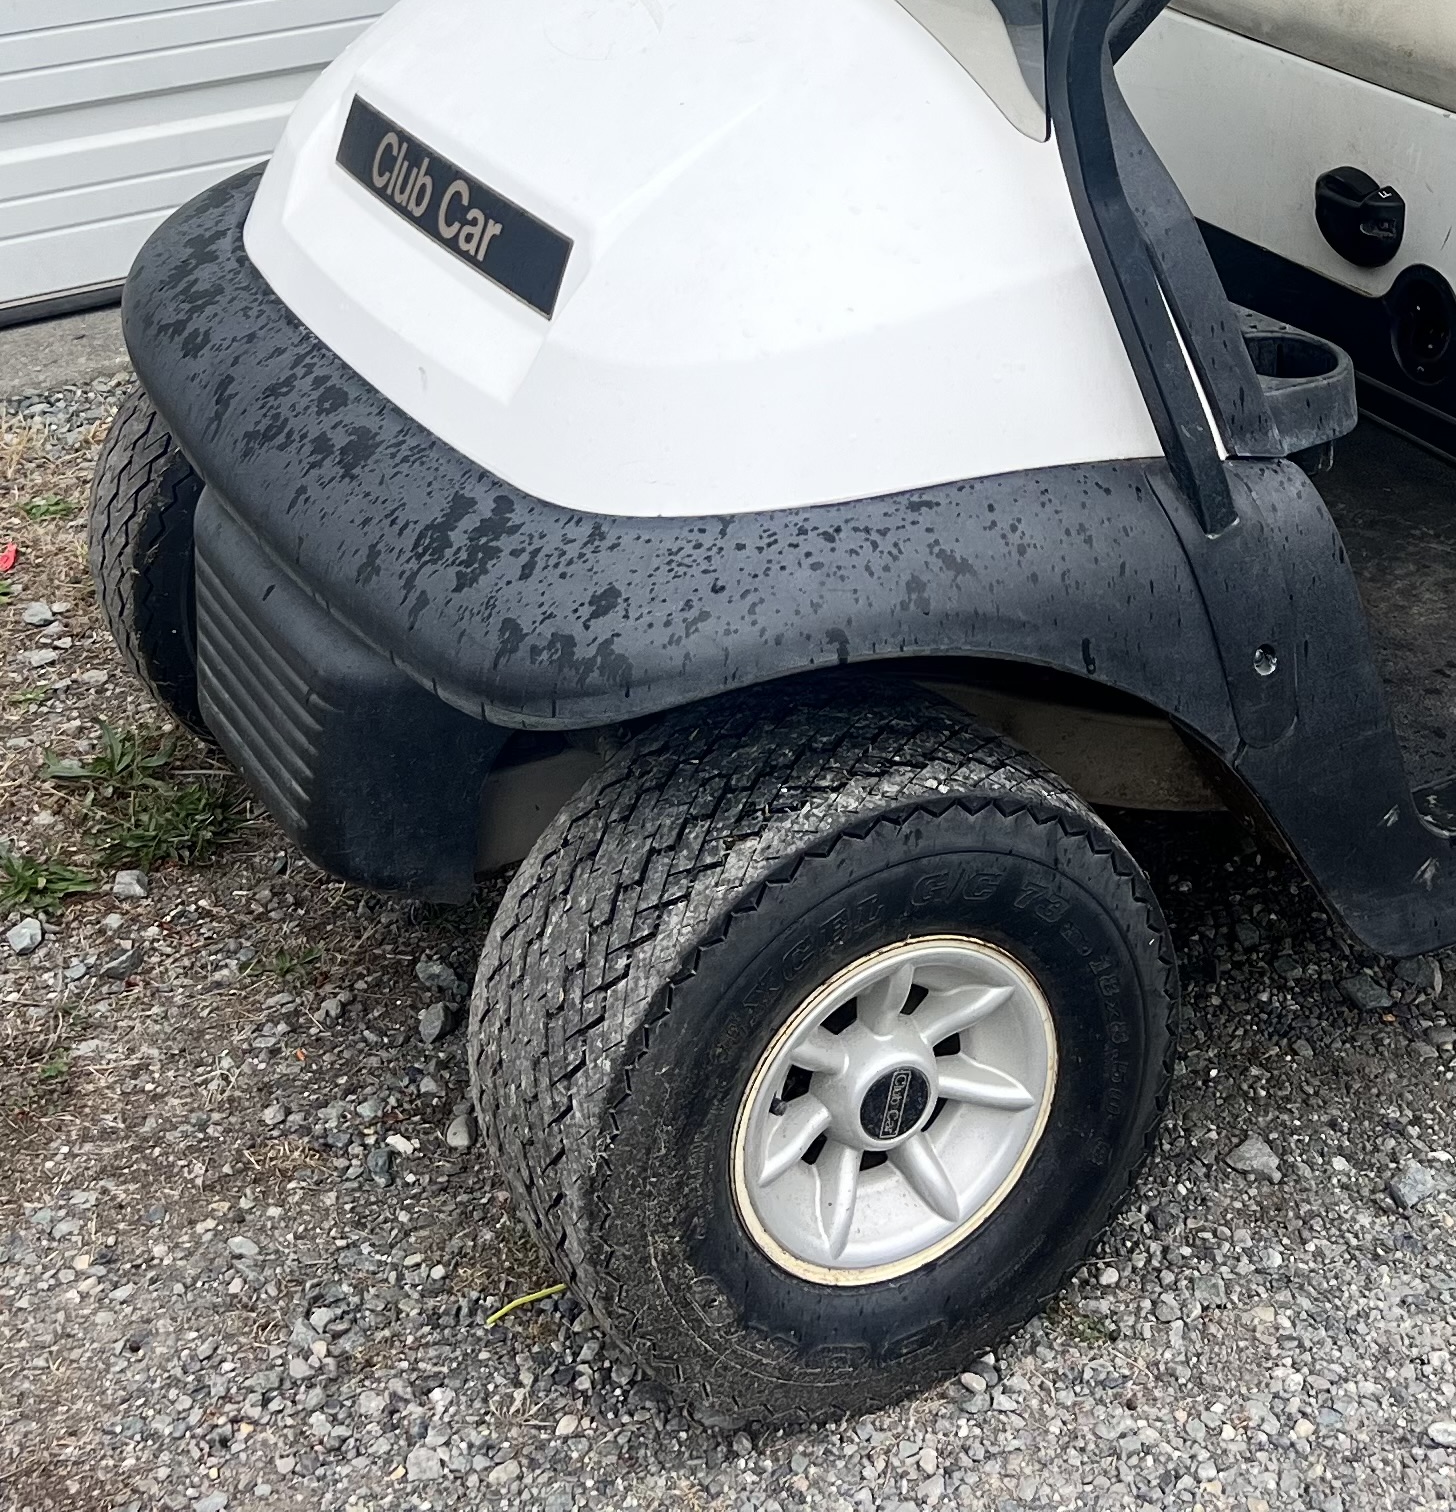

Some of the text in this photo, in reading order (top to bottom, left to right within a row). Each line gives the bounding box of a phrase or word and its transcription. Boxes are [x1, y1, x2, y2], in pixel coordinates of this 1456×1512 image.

[372, 131, 503, 262] Club Car
[884, 1074, 907, 1134] Club Car
